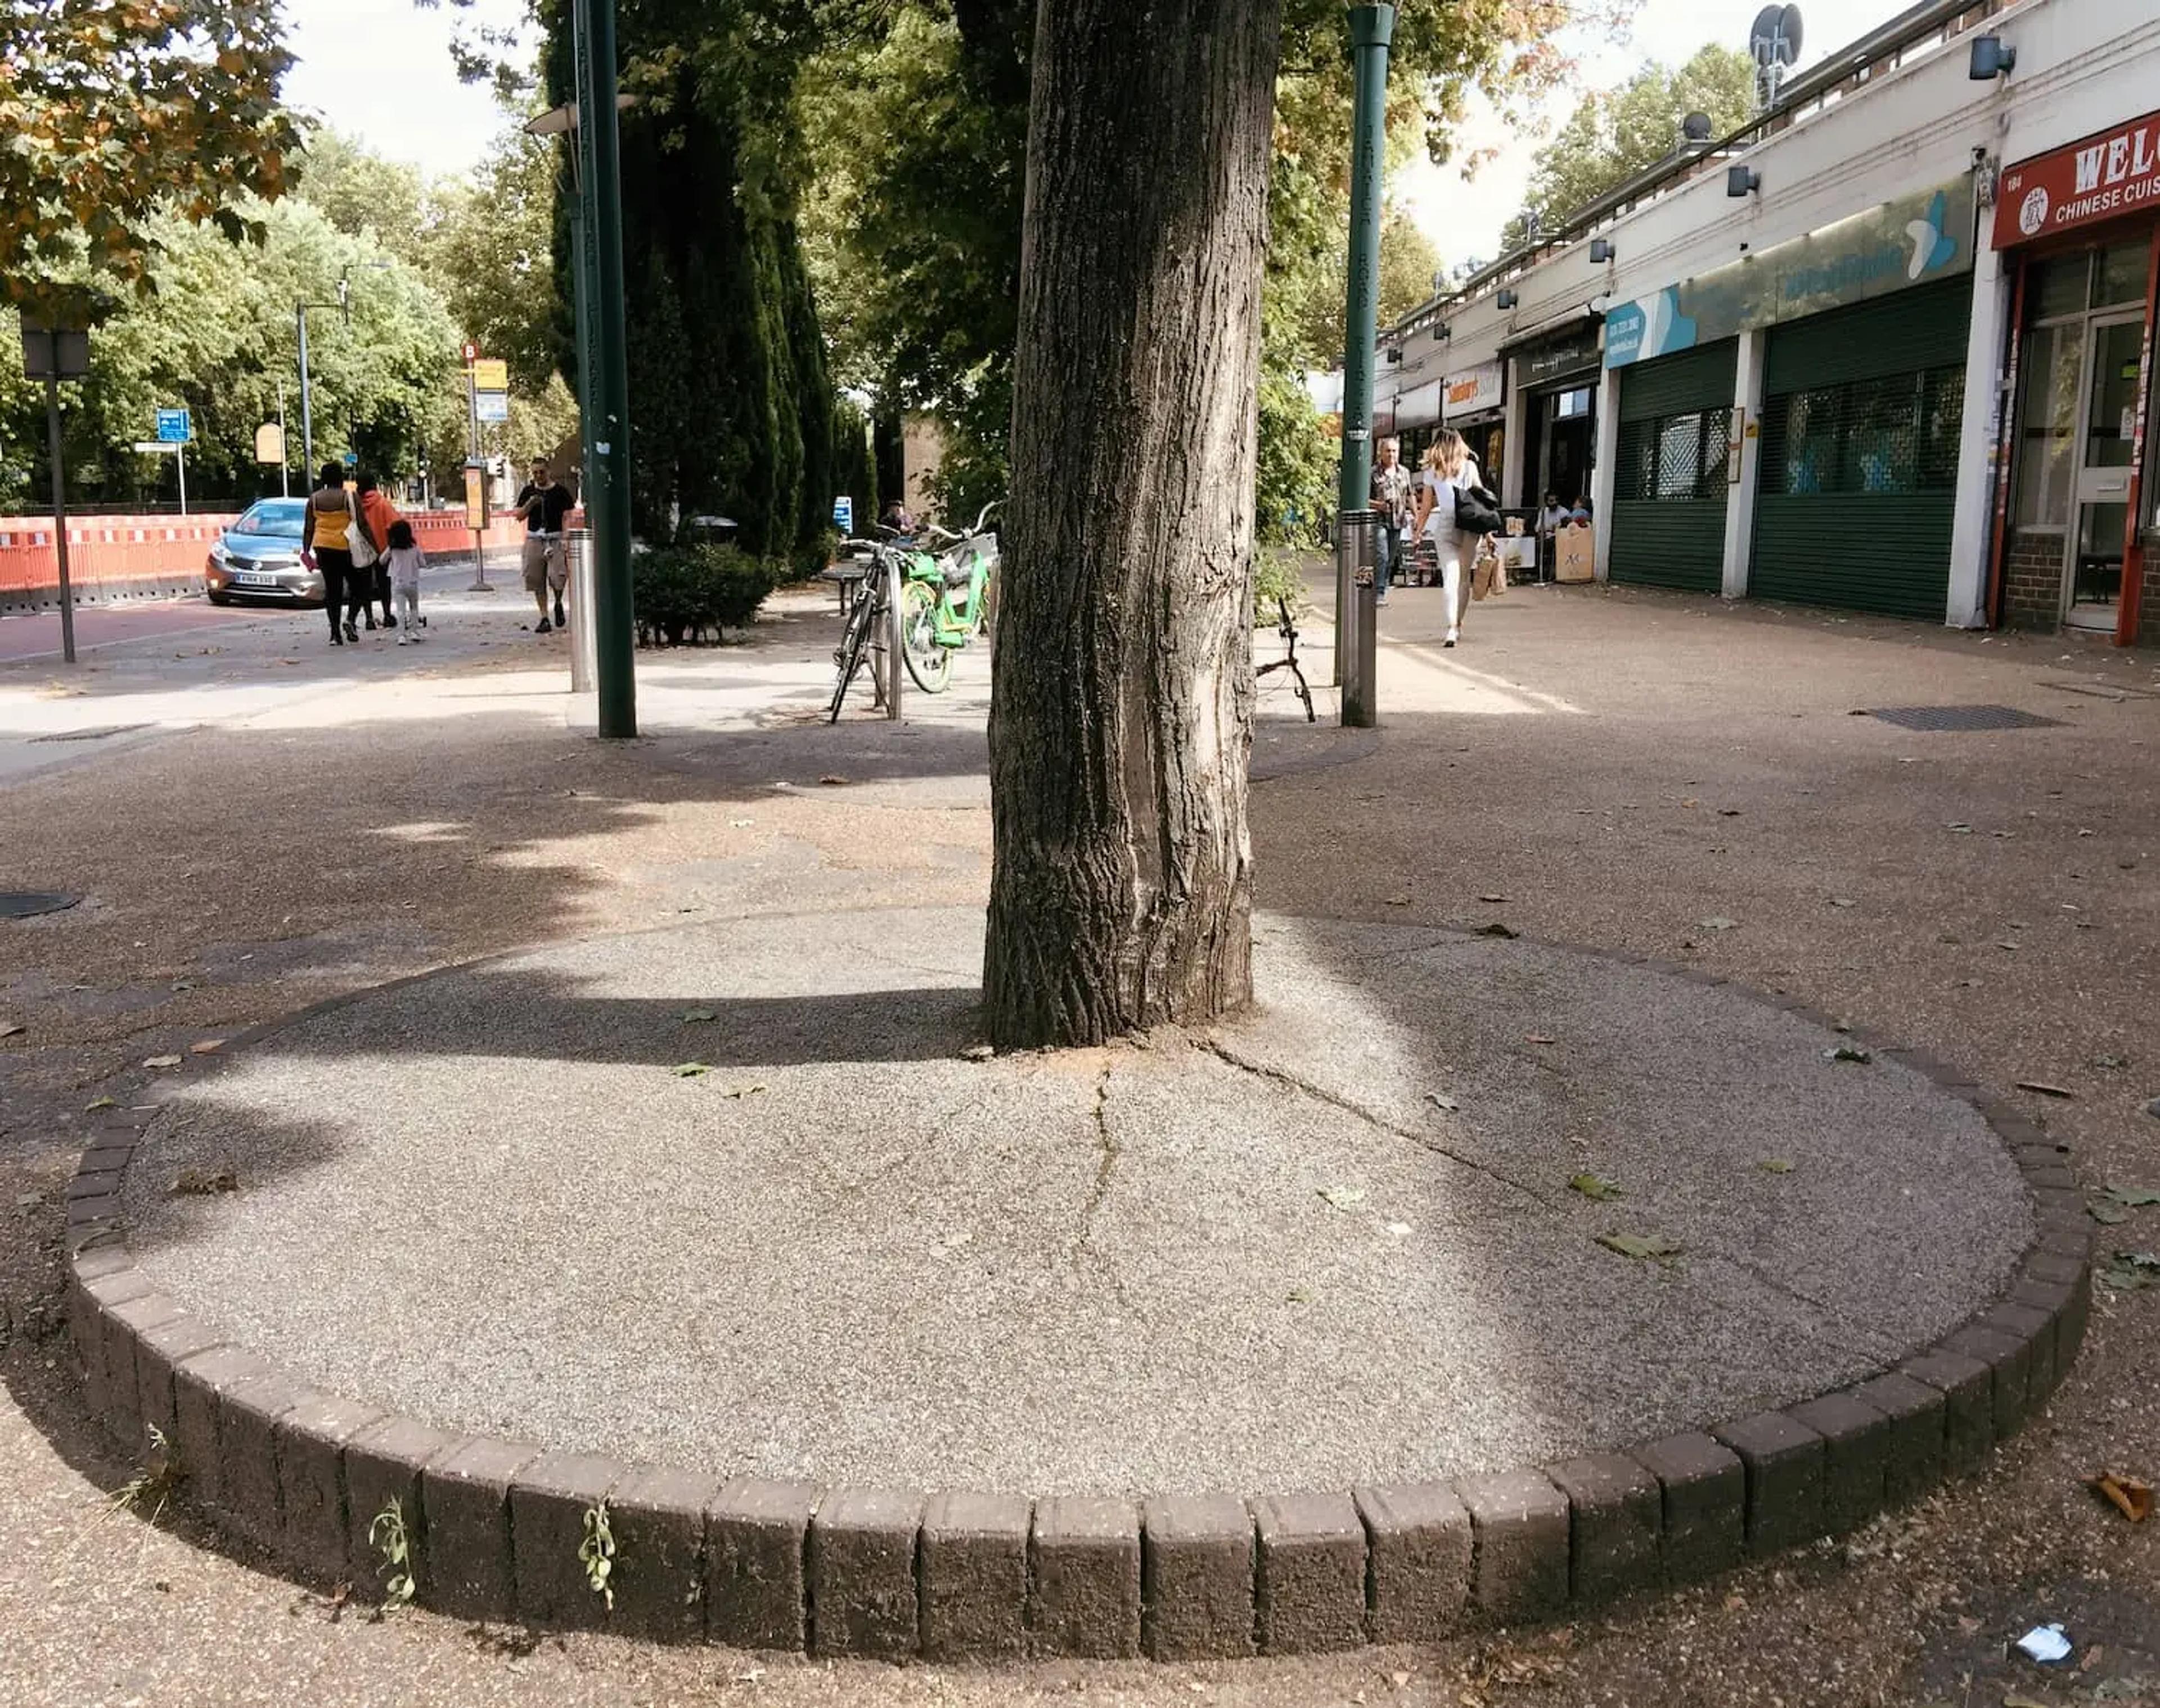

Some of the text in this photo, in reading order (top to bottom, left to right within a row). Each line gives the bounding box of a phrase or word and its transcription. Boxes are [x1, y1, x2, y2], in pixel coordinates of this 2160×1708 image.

[1360, 125, 1374, 224] JAMAICA
[2074, 128, 2160, 195] WEL
[2056, 189, 2120, 222] CHINESE
[1358, 253, 1369, 308] ROAD
[466, 345, 475, 358] B
